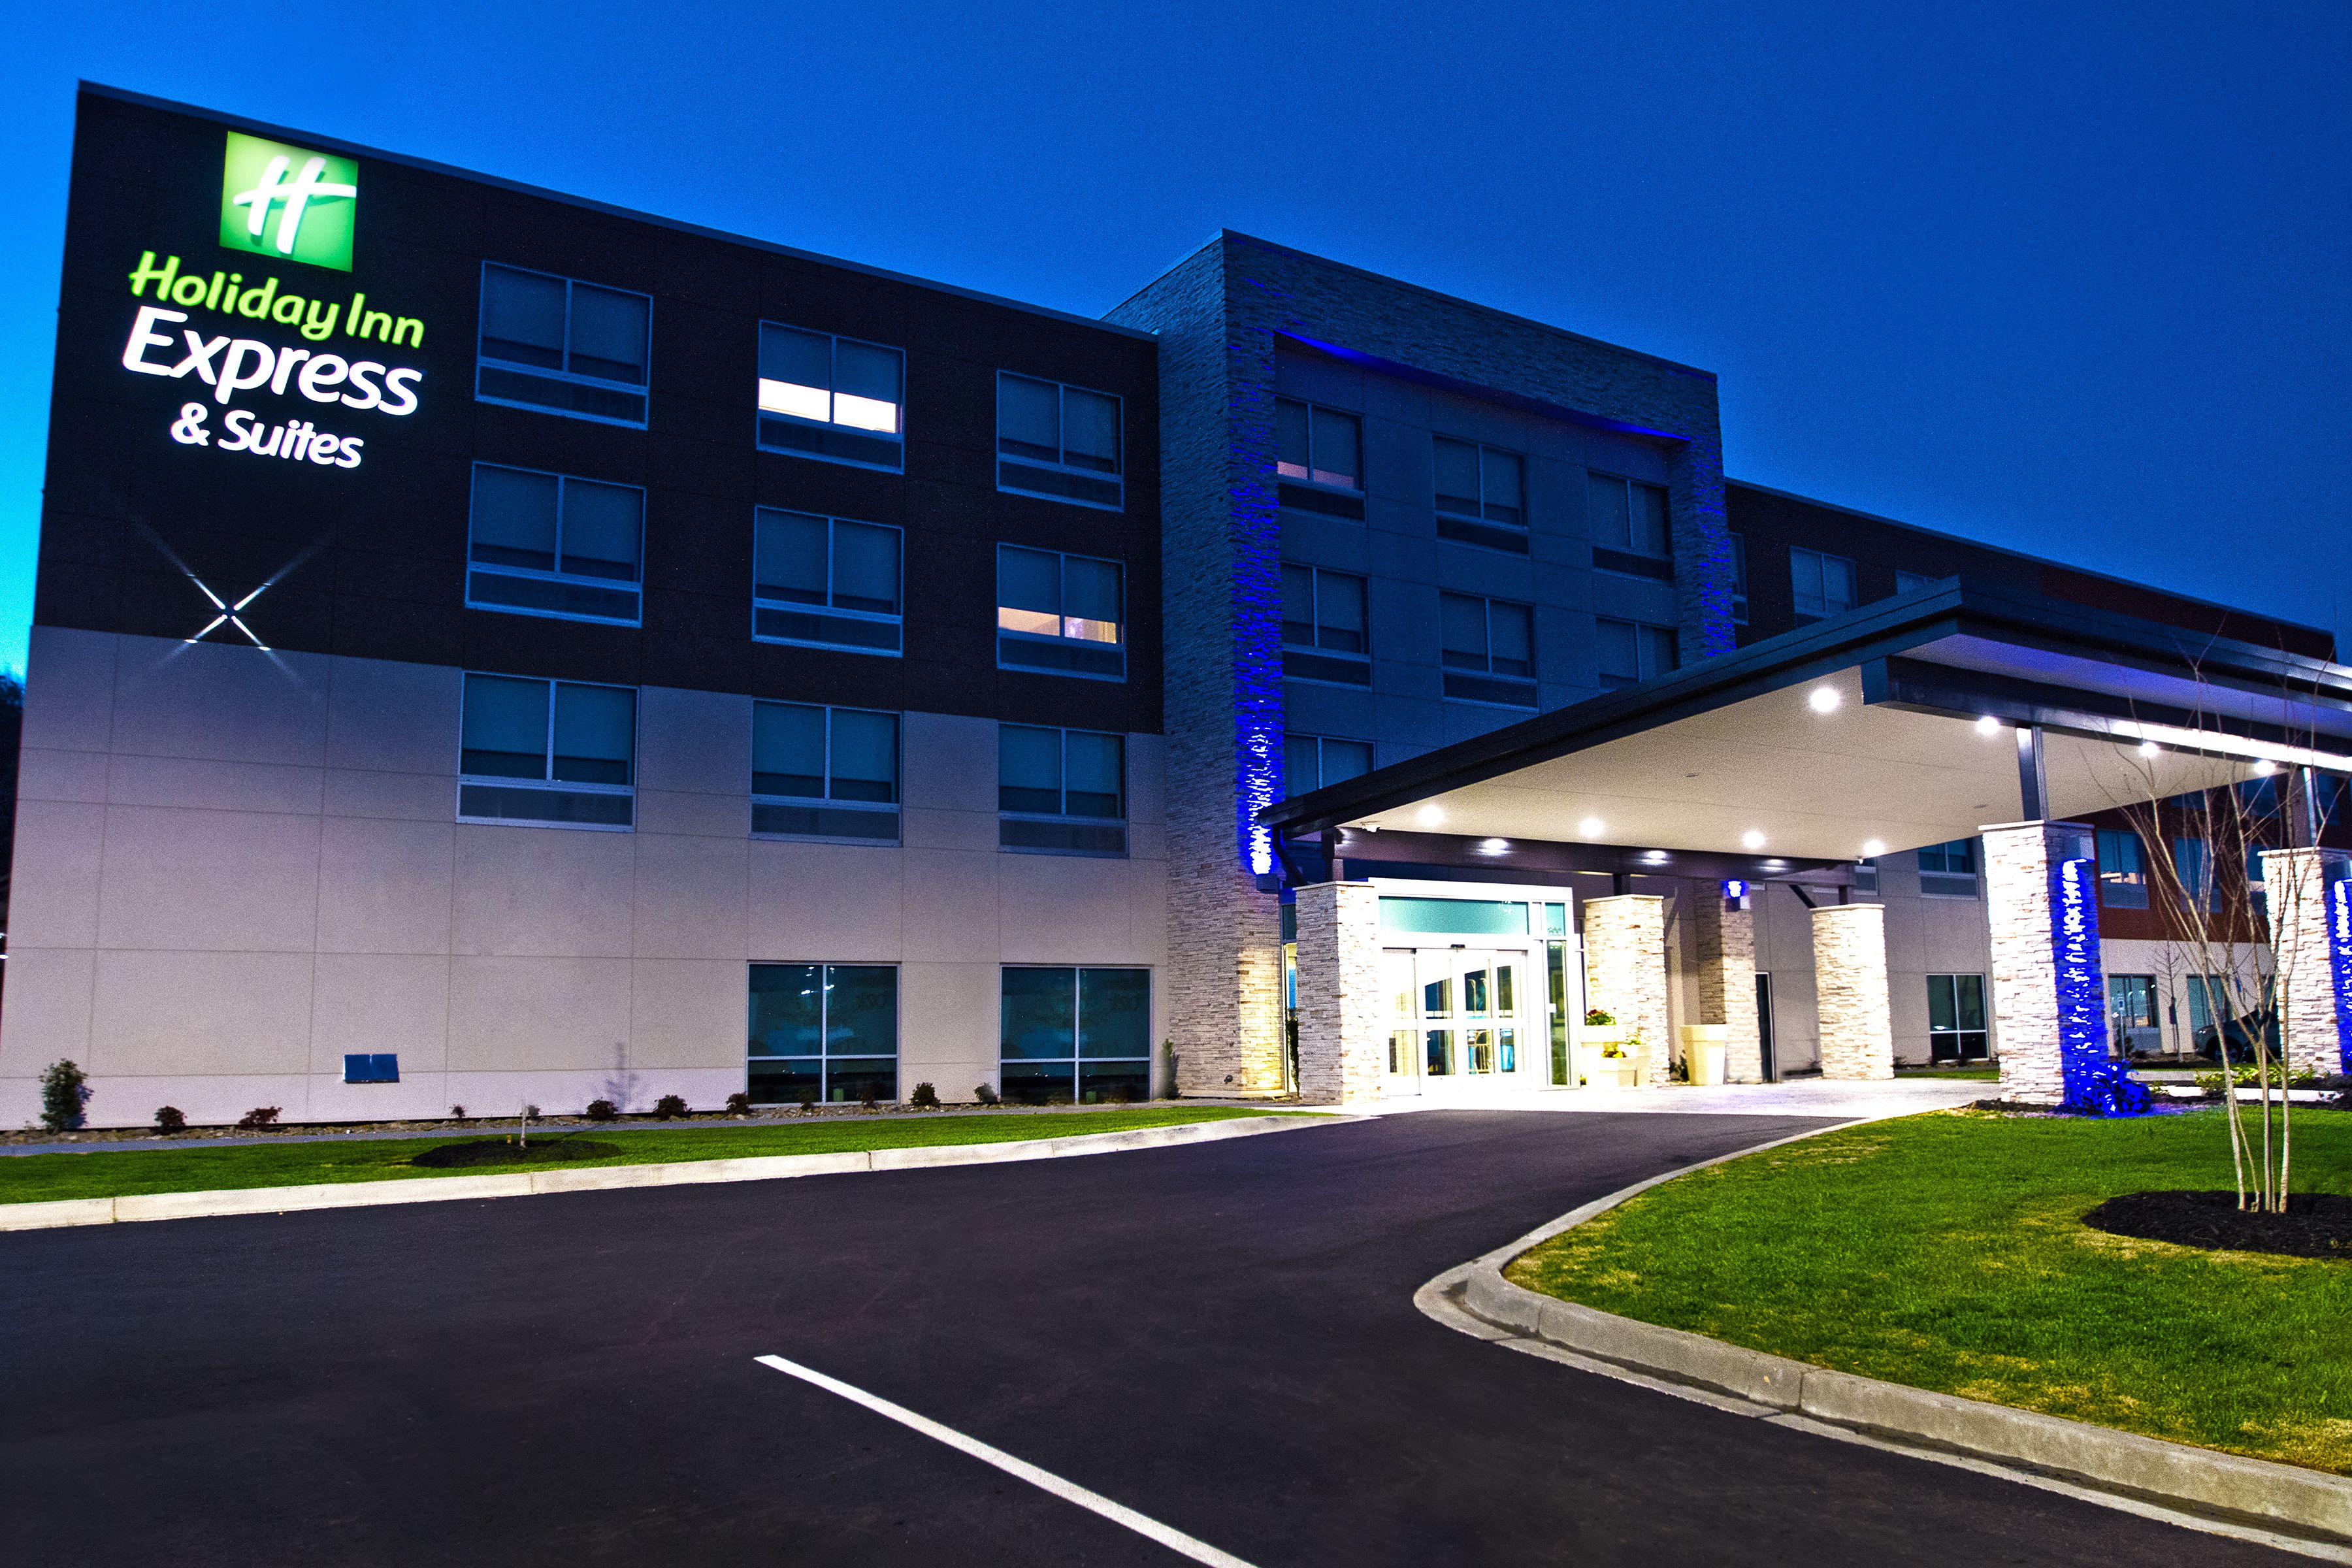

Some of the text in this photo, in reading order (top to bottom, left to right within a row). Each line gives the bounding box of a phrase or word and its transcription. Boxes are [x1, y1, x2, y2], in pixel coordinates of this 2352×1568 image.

[233, 155, 358, 255] H
[128, 250, 425, 348] Holiday Inn
[122, 305, 423, 416] Express
[171, 402, 365, 468] & Suites
